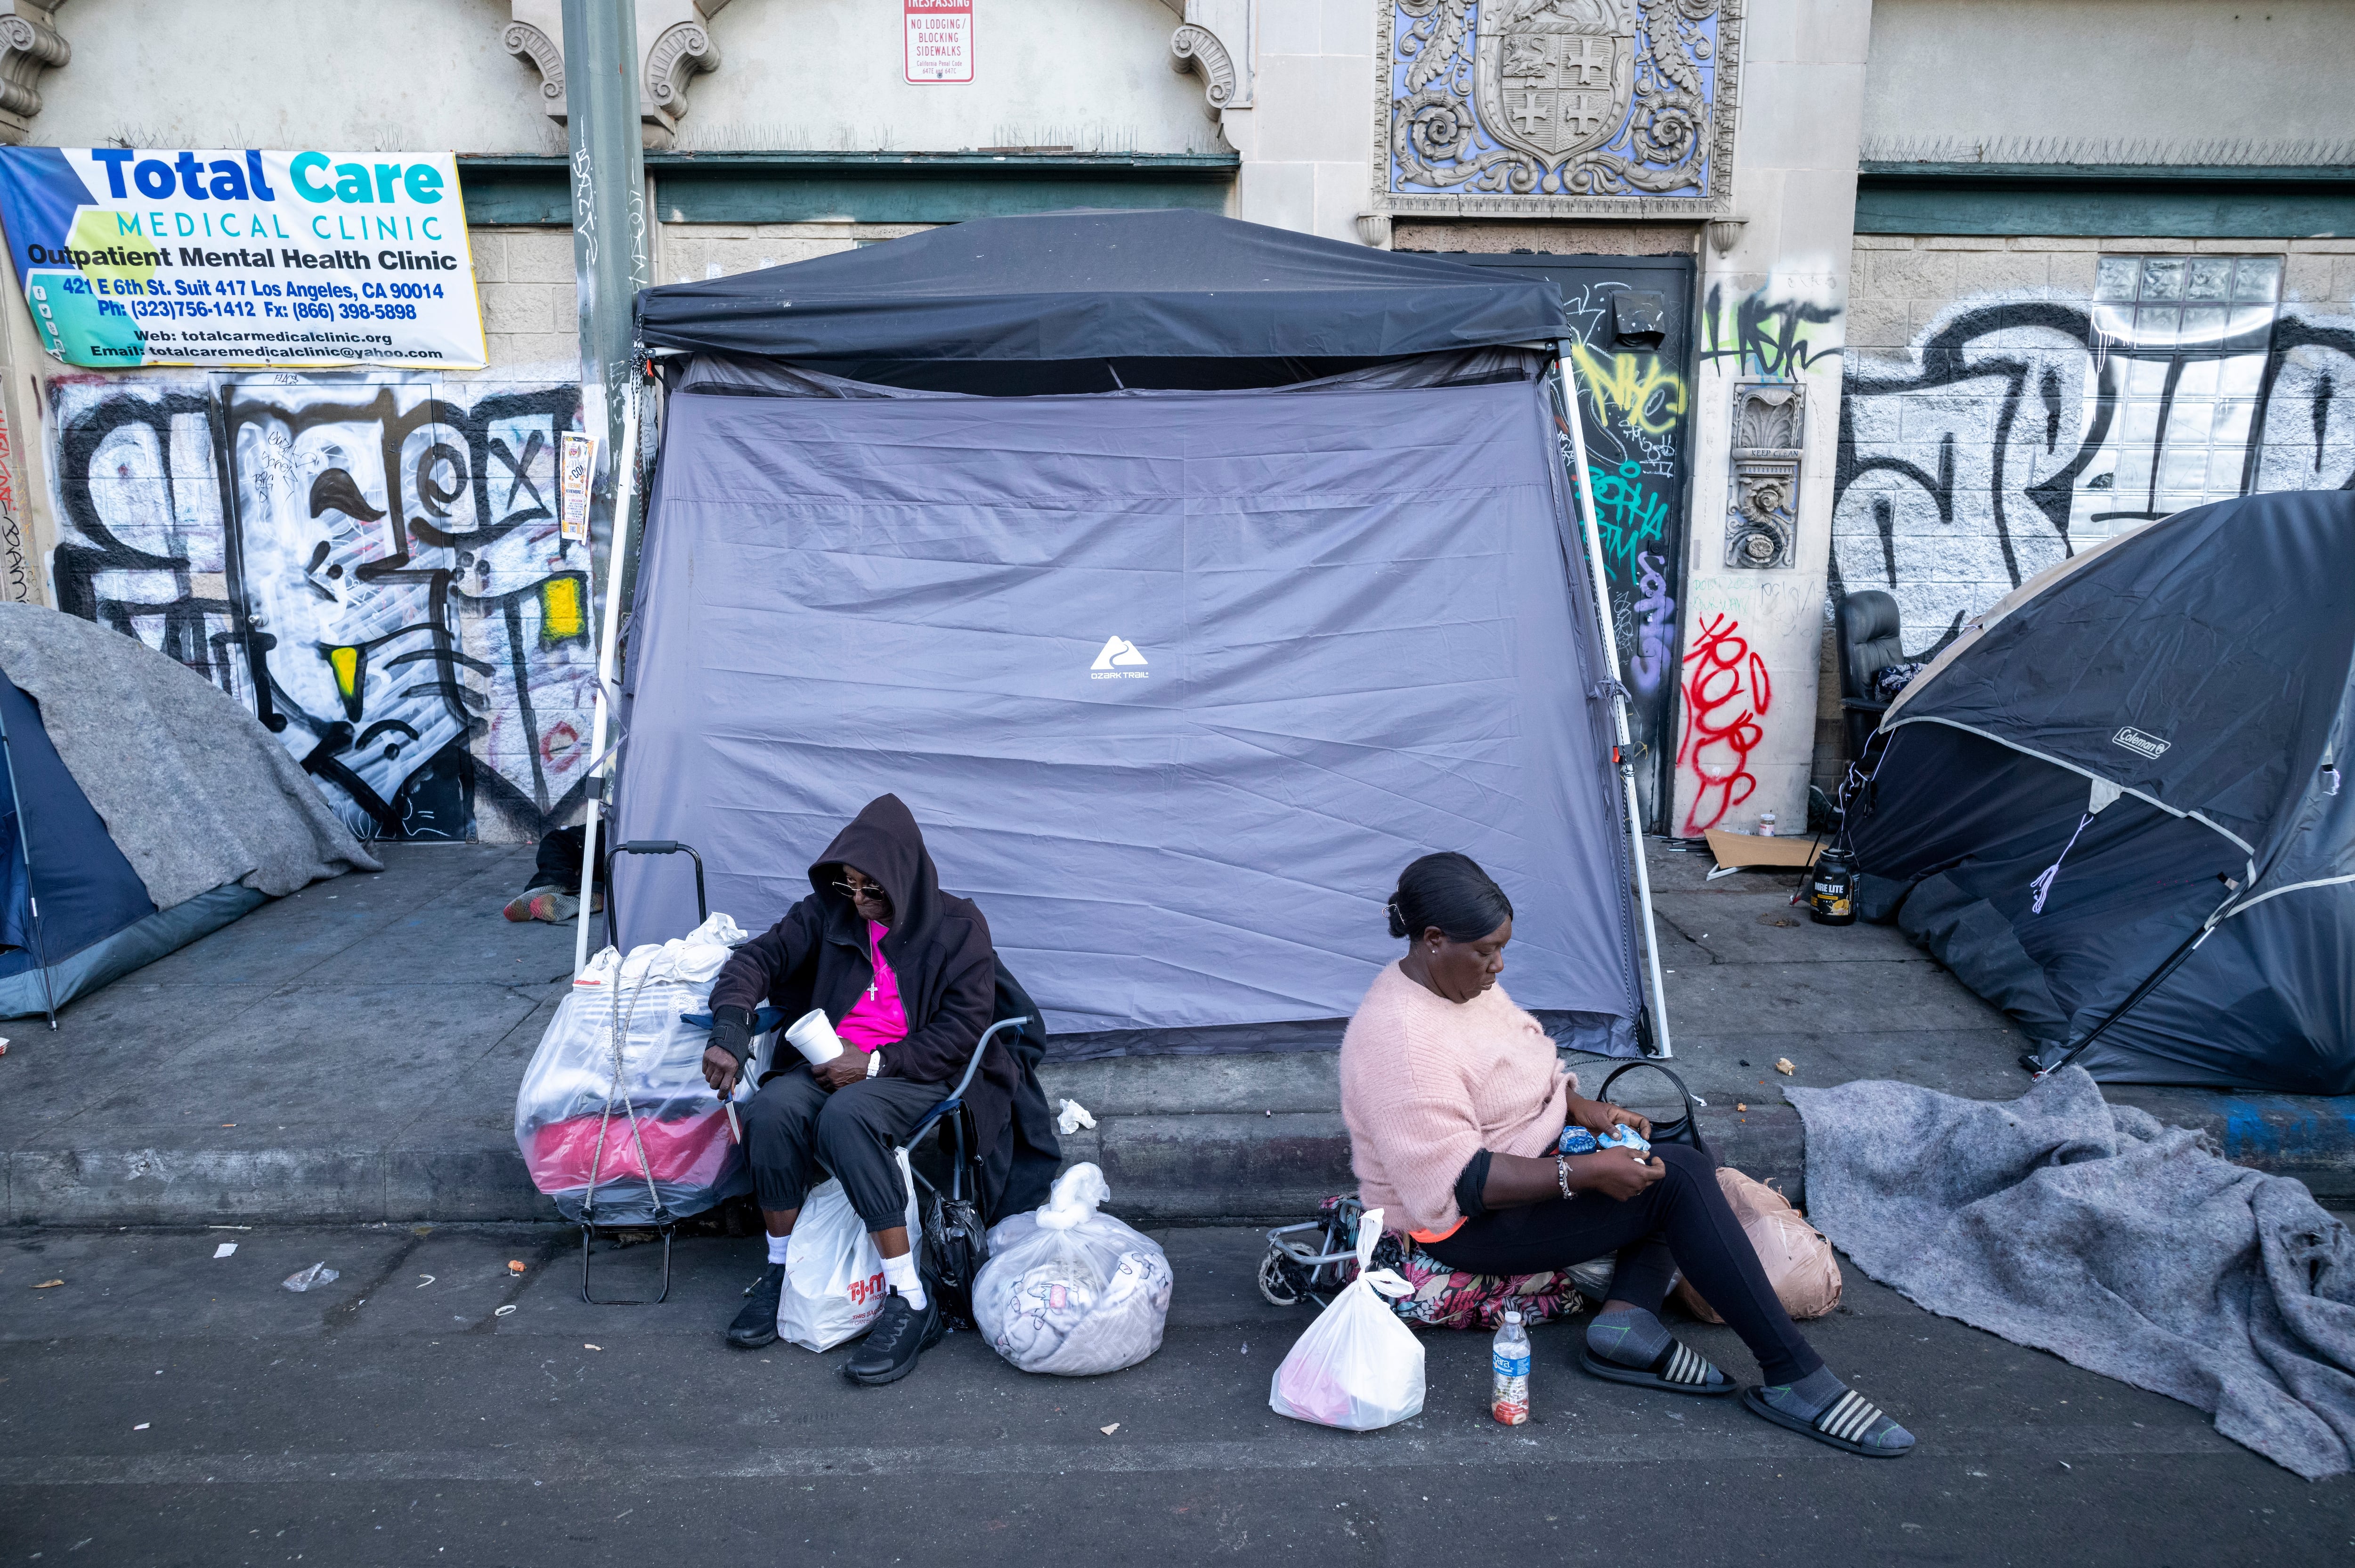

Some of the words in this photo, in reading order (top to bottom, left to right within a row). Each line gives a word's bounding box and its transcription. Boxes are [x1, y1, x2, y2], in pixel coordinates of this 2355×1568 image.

[911, 19, 921, 29] NO
[919, 32, 958, 42] BLOCKING
[917, 46, 961, 56] SIDEWALKS
[92, 149, 275, 202] Total
[290, 152, 445, 204] Care
[116, 212, 289, 238] MEDICAL
[313, 215, 442, 241] CLINIC
[28, 244, 171, 268] Outpatient
[179, 247, 275, 268] Mental
[283, 249, 371, 269] Health
[378, 250, 458, 270] Clinic
[63, 277, 93, 294] 421
[97, 278, 110, 294] E
[114, 279, 142, 295] 6th
[146, 279, 171, 296] St.
[176, 279, 212, 296] Suit
[215, 280, 246, 296] 417
[251, 280, 282, 297] Los
[286, 281, 358, 301] Angeles,
[362, 282, 388, 299] CA
[390, 283, 444, 299] 90014
[97, 300, 127, 316] Ph:
[131, 300, 256, 320] (323)756-1412
[264, 301, 289, 317] Fx:
[293, 302, 334, 322] (866)
[339, 303, 417, 320] 398-5898
[134, 331, 177, 341] Web:
[181, 331, 392, 345] totalcarmedicalclinic.org
[90, 346, 145, 356] Email:
[148, 346, 443, 358] totalcaremedicalclinic@yahoo.com
[2120, 729, 2156, 752] Coleman
[1815, 882, 1827, 892] MRE
[1828, 885, 1843, 894] LITE
